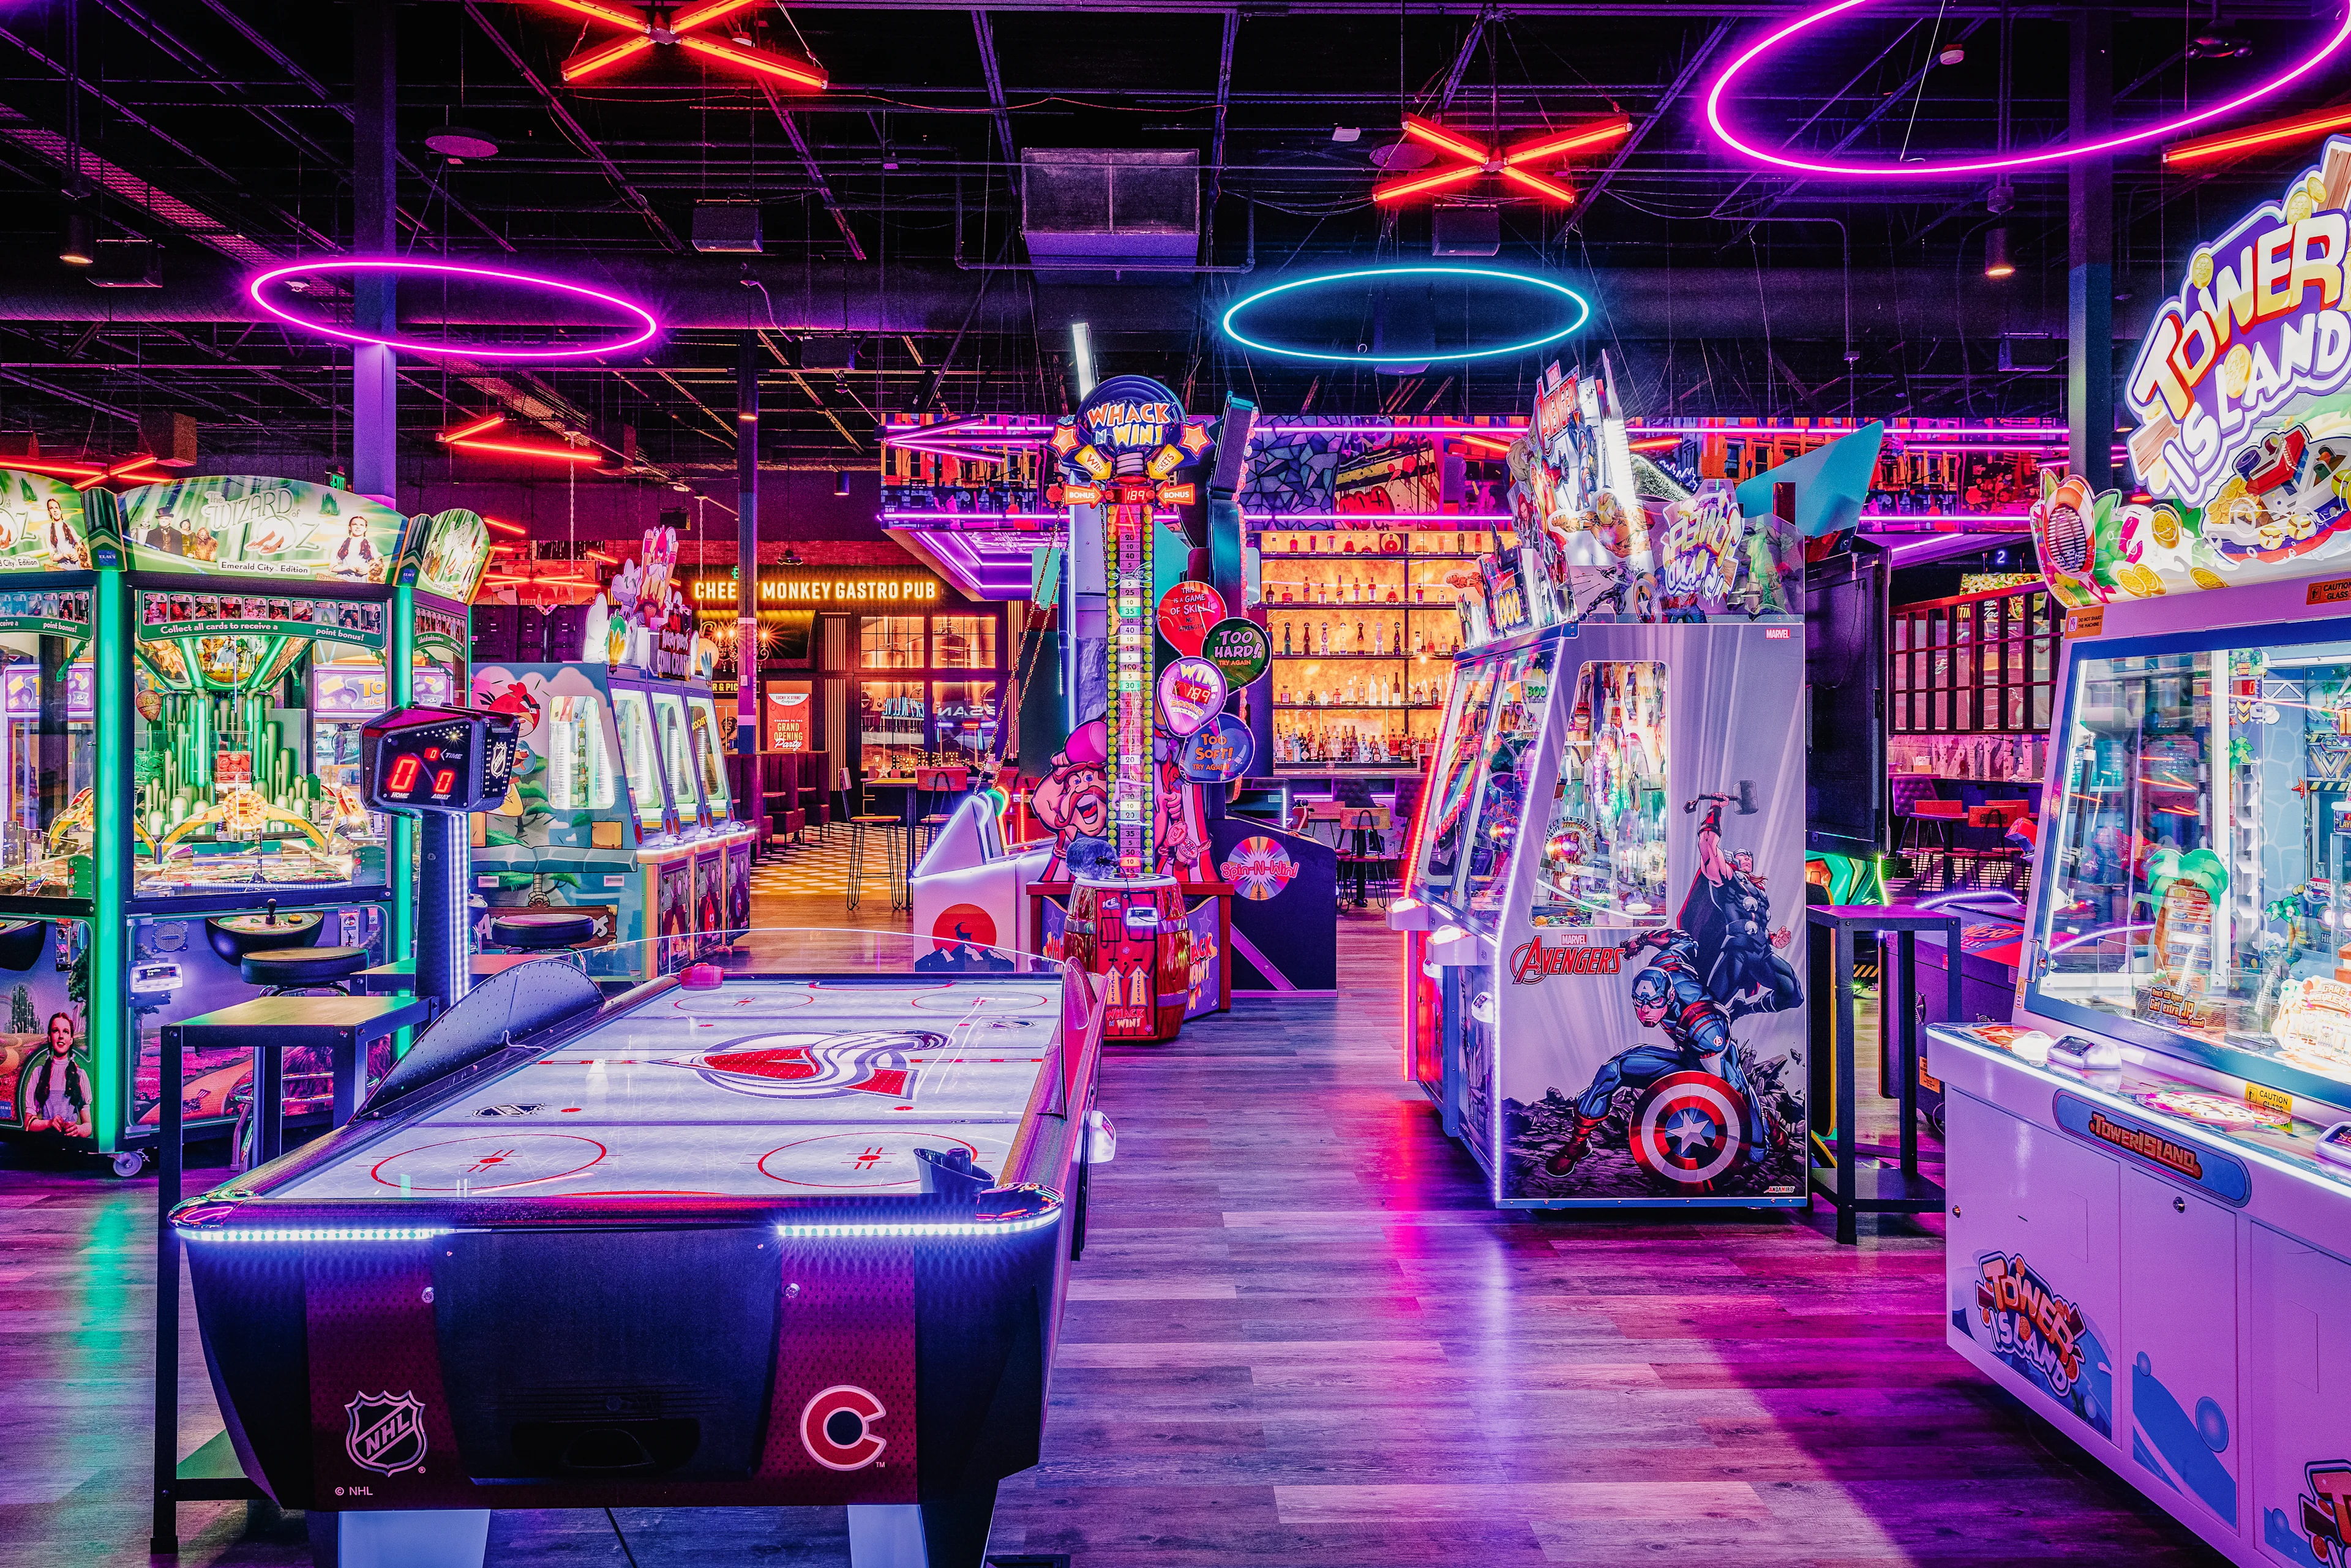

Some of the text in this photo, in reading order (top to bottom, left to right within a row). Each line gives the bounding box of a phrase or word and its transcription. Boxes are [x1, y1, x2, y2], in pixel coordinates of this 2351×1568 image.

[2133, 212, 2348, 420] TOWER
[2164, 311, 2351, 493] ISLAND
[1087, 402, 1171, 428] WHACK
[1112, 424, 1163, 446] WIN!
[1086, 453, 1103, 473] WIN
[1154, 452, 1175, 473] TICKETS
[209, 493, 223, 504] The
[1127, 490, 1145, 501] 189
[207, 489, 301, 530] WIZARD of
[1997, 551, 2005, 563] 2
[221, 561, 309, 574] Emerald City Edition
[696, 582, 936, 599] CHEE MONKEY GASTRO PUB
[2327, 591, 2349, 600] GLASS
[1185, 594, 1206, 603] GAME
[1184, 602, 1211, 615] SKILL!
[59, 623, 77, 632] bonus!
[160, 624, 192, 634] Collect
[193, 622, 204, 632] all
[206, 622, 228, 631] cards
[316, 628, 336, 638] point
[338, 631, 365, 642] bonus!
[1179, 623, 1204, 632] STRENGTH
[1766, 629, 1790, 639] MARVEL
[662, 629, 676, 651] ANGRY
[675, 632, 689, 651] BIRDS
[1219, 630, 1254, 646] TOO
[1214, 642, 1262, 659] HARD!
[1180, 663, 1218, 687] WIN
[1188, 687, 1210, 702] 189
[1526, 686, 1547, 697] 300
[2249, 681, 2255, 694] 0
[1170, 700, 1204, 716] BONUS
[777, 722, 800, 732] GRAND
[774, 732, 803, 741] OPENING
[1201, 733, 1228, 745] TOO
[774, 738, 803, 752] Party
[430, 749, 438, 759] 0
[1195, 747, 1234, 762] SOFT!
[391, 759, 417, 790] 0
[435, 772, 452, 792] 0
[1221, 859, 1299, 880] Spin-N-Win!
[1102, 897, 1118, 910] ICE
[1961, 925, 2025, 938] NERF
[1562, 934, 1586, 945] MARVEL
[1190, 934, 1213, 966] ACK
[1510, 936, 1626, 985] AVENGERS
[2151, 988, 2163, 998] Reach
[2171, 992, 2183, 1003] layers
[2323, 984, 2345, 995] GAME
[1106, 1008, 1144, 1019] WHACK
[2150, 997, 2195, 1018] Get extra JP
[1117, 1018, 1141, 1029] WIN!
[2259, 1090, 2289, 1105] CAUTION
[1981, 1255, 2075, 1365] TOWER
[1988, 1309, 2068, 1392] ISLAND
[365, 1413, 410, 1457] NHL
[800, 1384, 887, 1471] C
[349, 1486, 373, 1496] NHL
